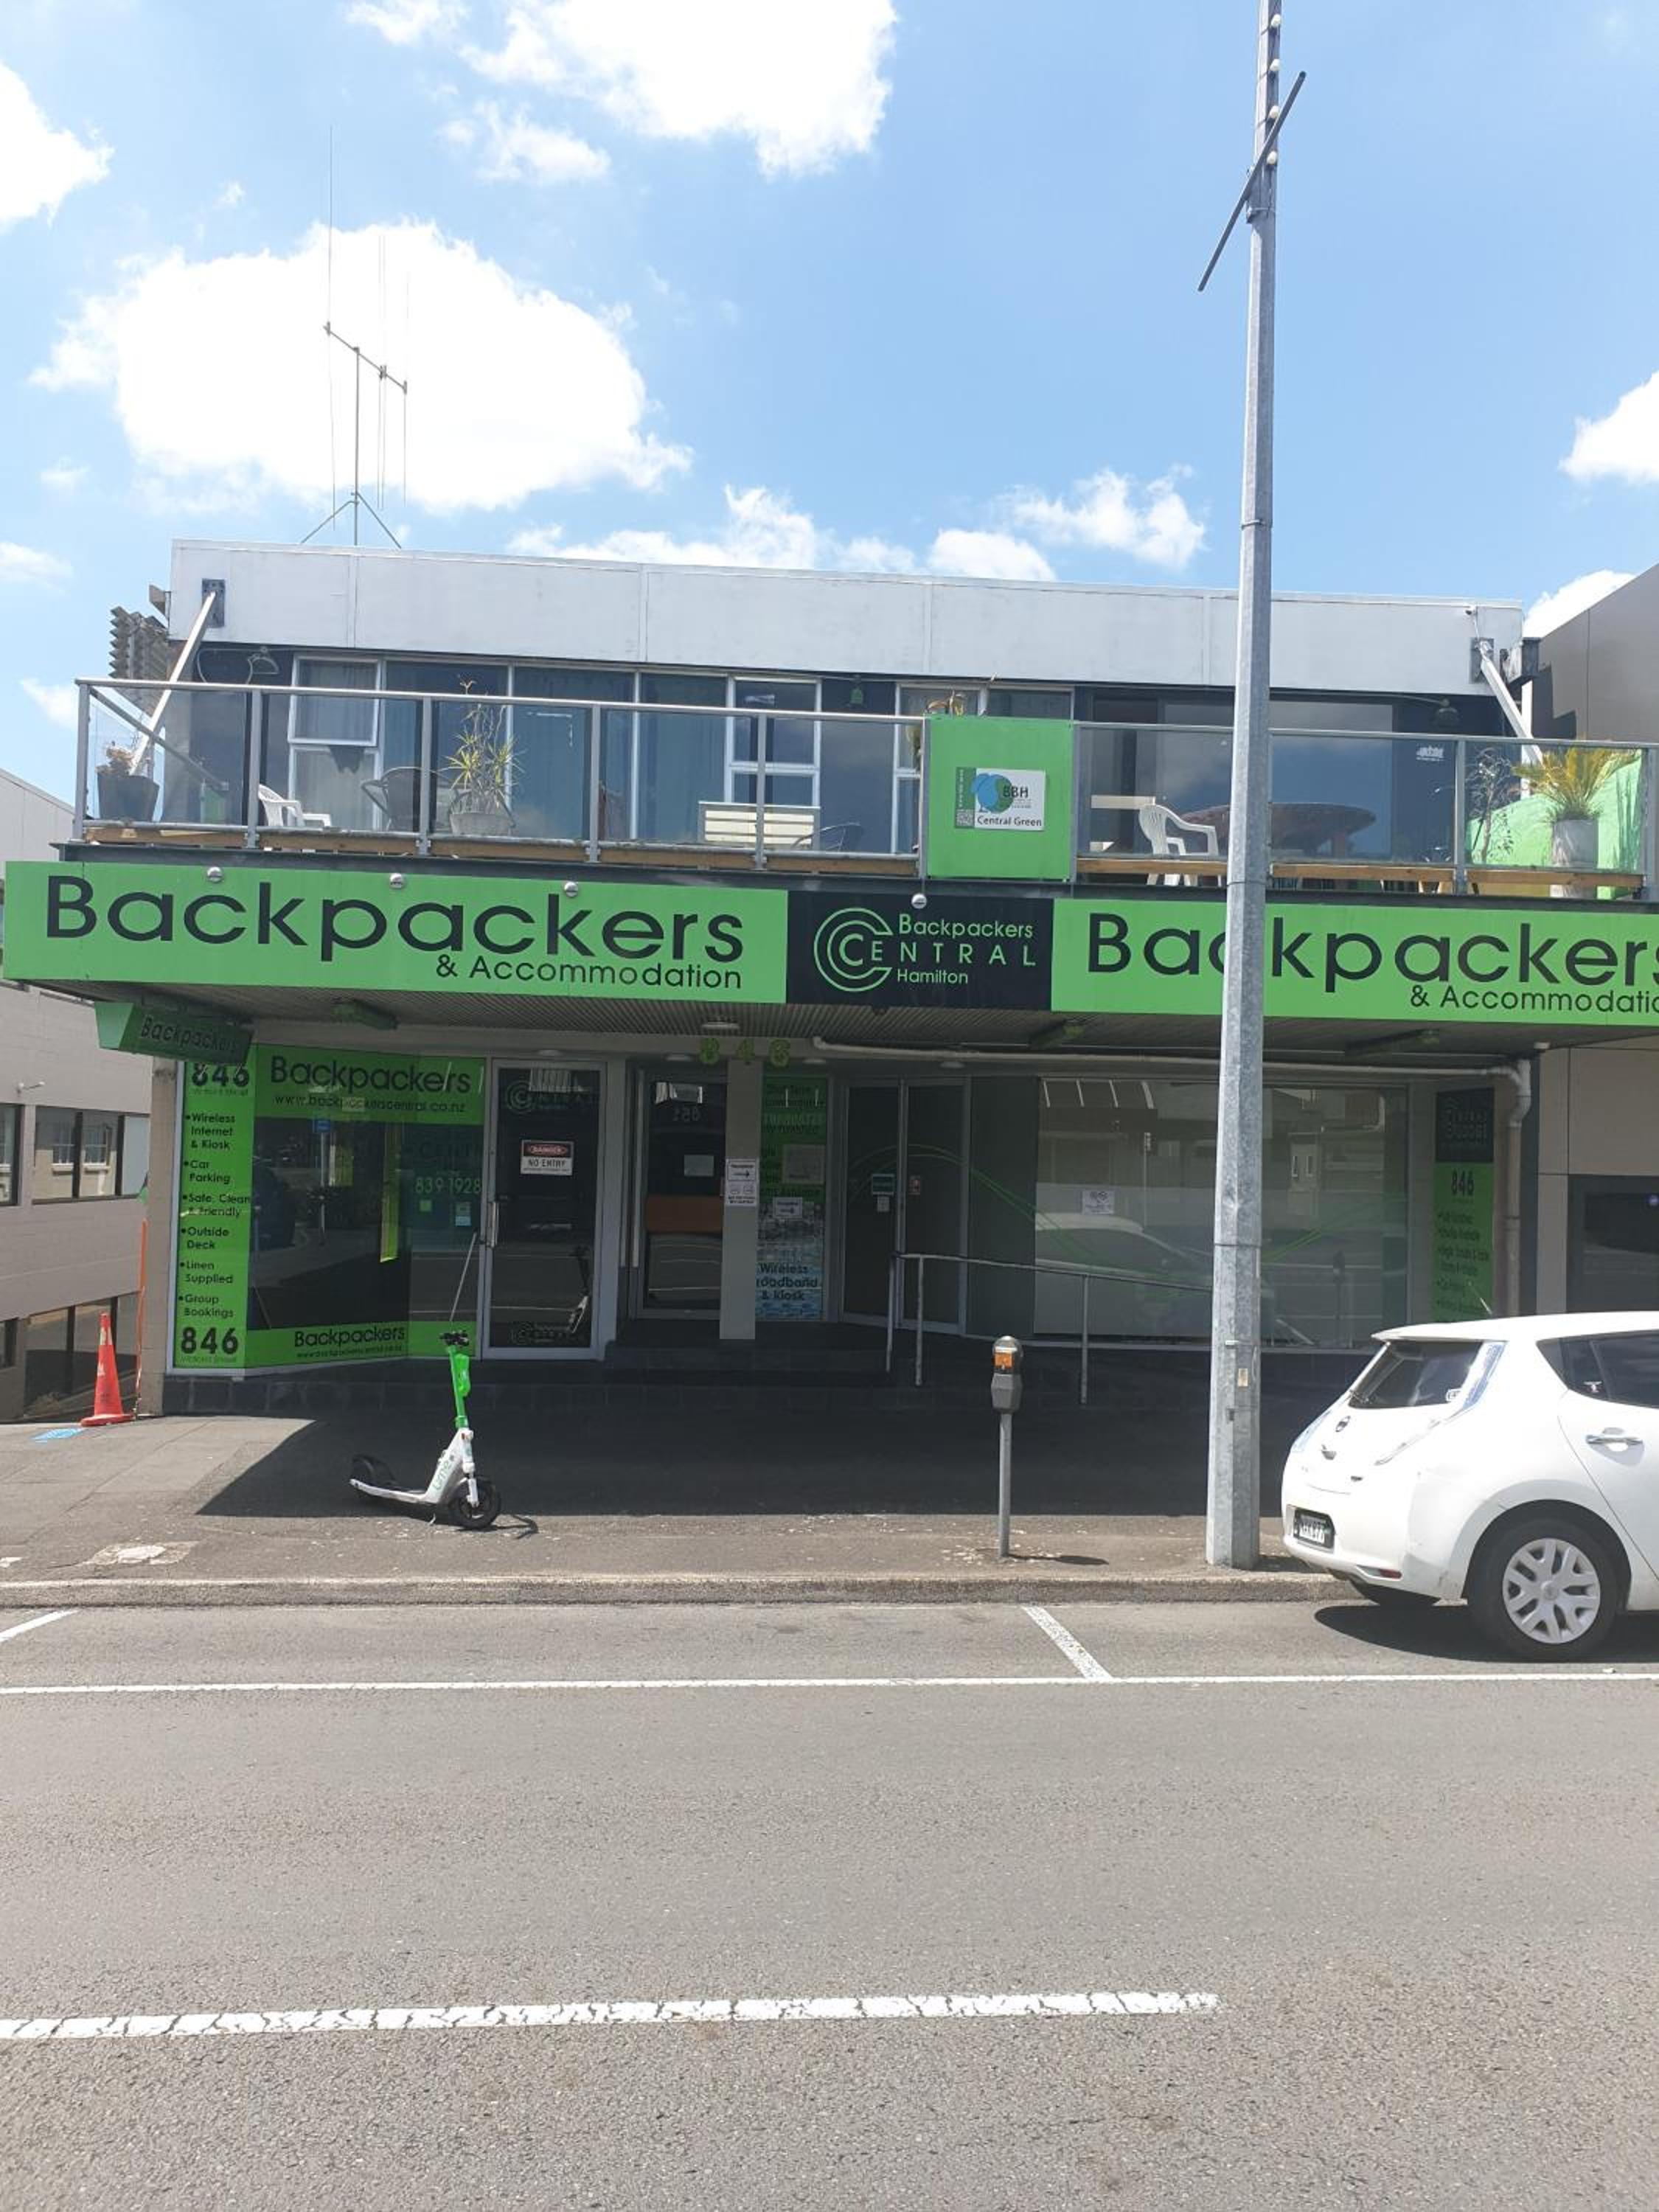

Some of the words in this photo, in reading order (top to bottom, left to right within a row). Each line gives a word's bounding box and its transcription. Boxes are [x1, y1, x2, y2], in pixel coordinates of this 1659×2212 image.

[1003, 785, 1029, 798] BBH
[977, 815, 1012, 825] Central
[1014, 816, 1042, 827] Green
[46, 874, 744, 963] Backpackers
[899, 914, 1033, 939] Backpackers
[1088, 912, 1659, 992] Bakpacker
[436, 954, 458, 978] &
[469, 955, 742, 989] Accommodation
[897, 968, 968, 984] Hamilton
[1410, 984, 1430, 1007] &
[192, 1062, 250, 1087] 846
[271, 1055, 471, 1094] Backpackers
[191, 1113, 235, 1123] Wireless
[191, 1126, 233, 1136] Internet
[201, 1139, 231, 1150] Kiosk
[189, 1160, 209, 1169] Car
[528, 1158, 539, 1167] NO
[542, 1158, 567, 1167] ENTRY
[189, 1172, 231, 1185] Parking
[187, 1226, 230, 1237] Outside
[187, 1239, 215, 1249] Deck
[186, 1260, 215, 1270] Linen
[185, 1273, 234, 1284] Supplied
[756, 1276, 818, 1287] roadband
[184, 1294, 219, 1305] Group
[184, 1307, 234, 1319] Bookings
[181, 1326, 239, 1355] 846
[295, 1325, 405, 1347] Backpackers
